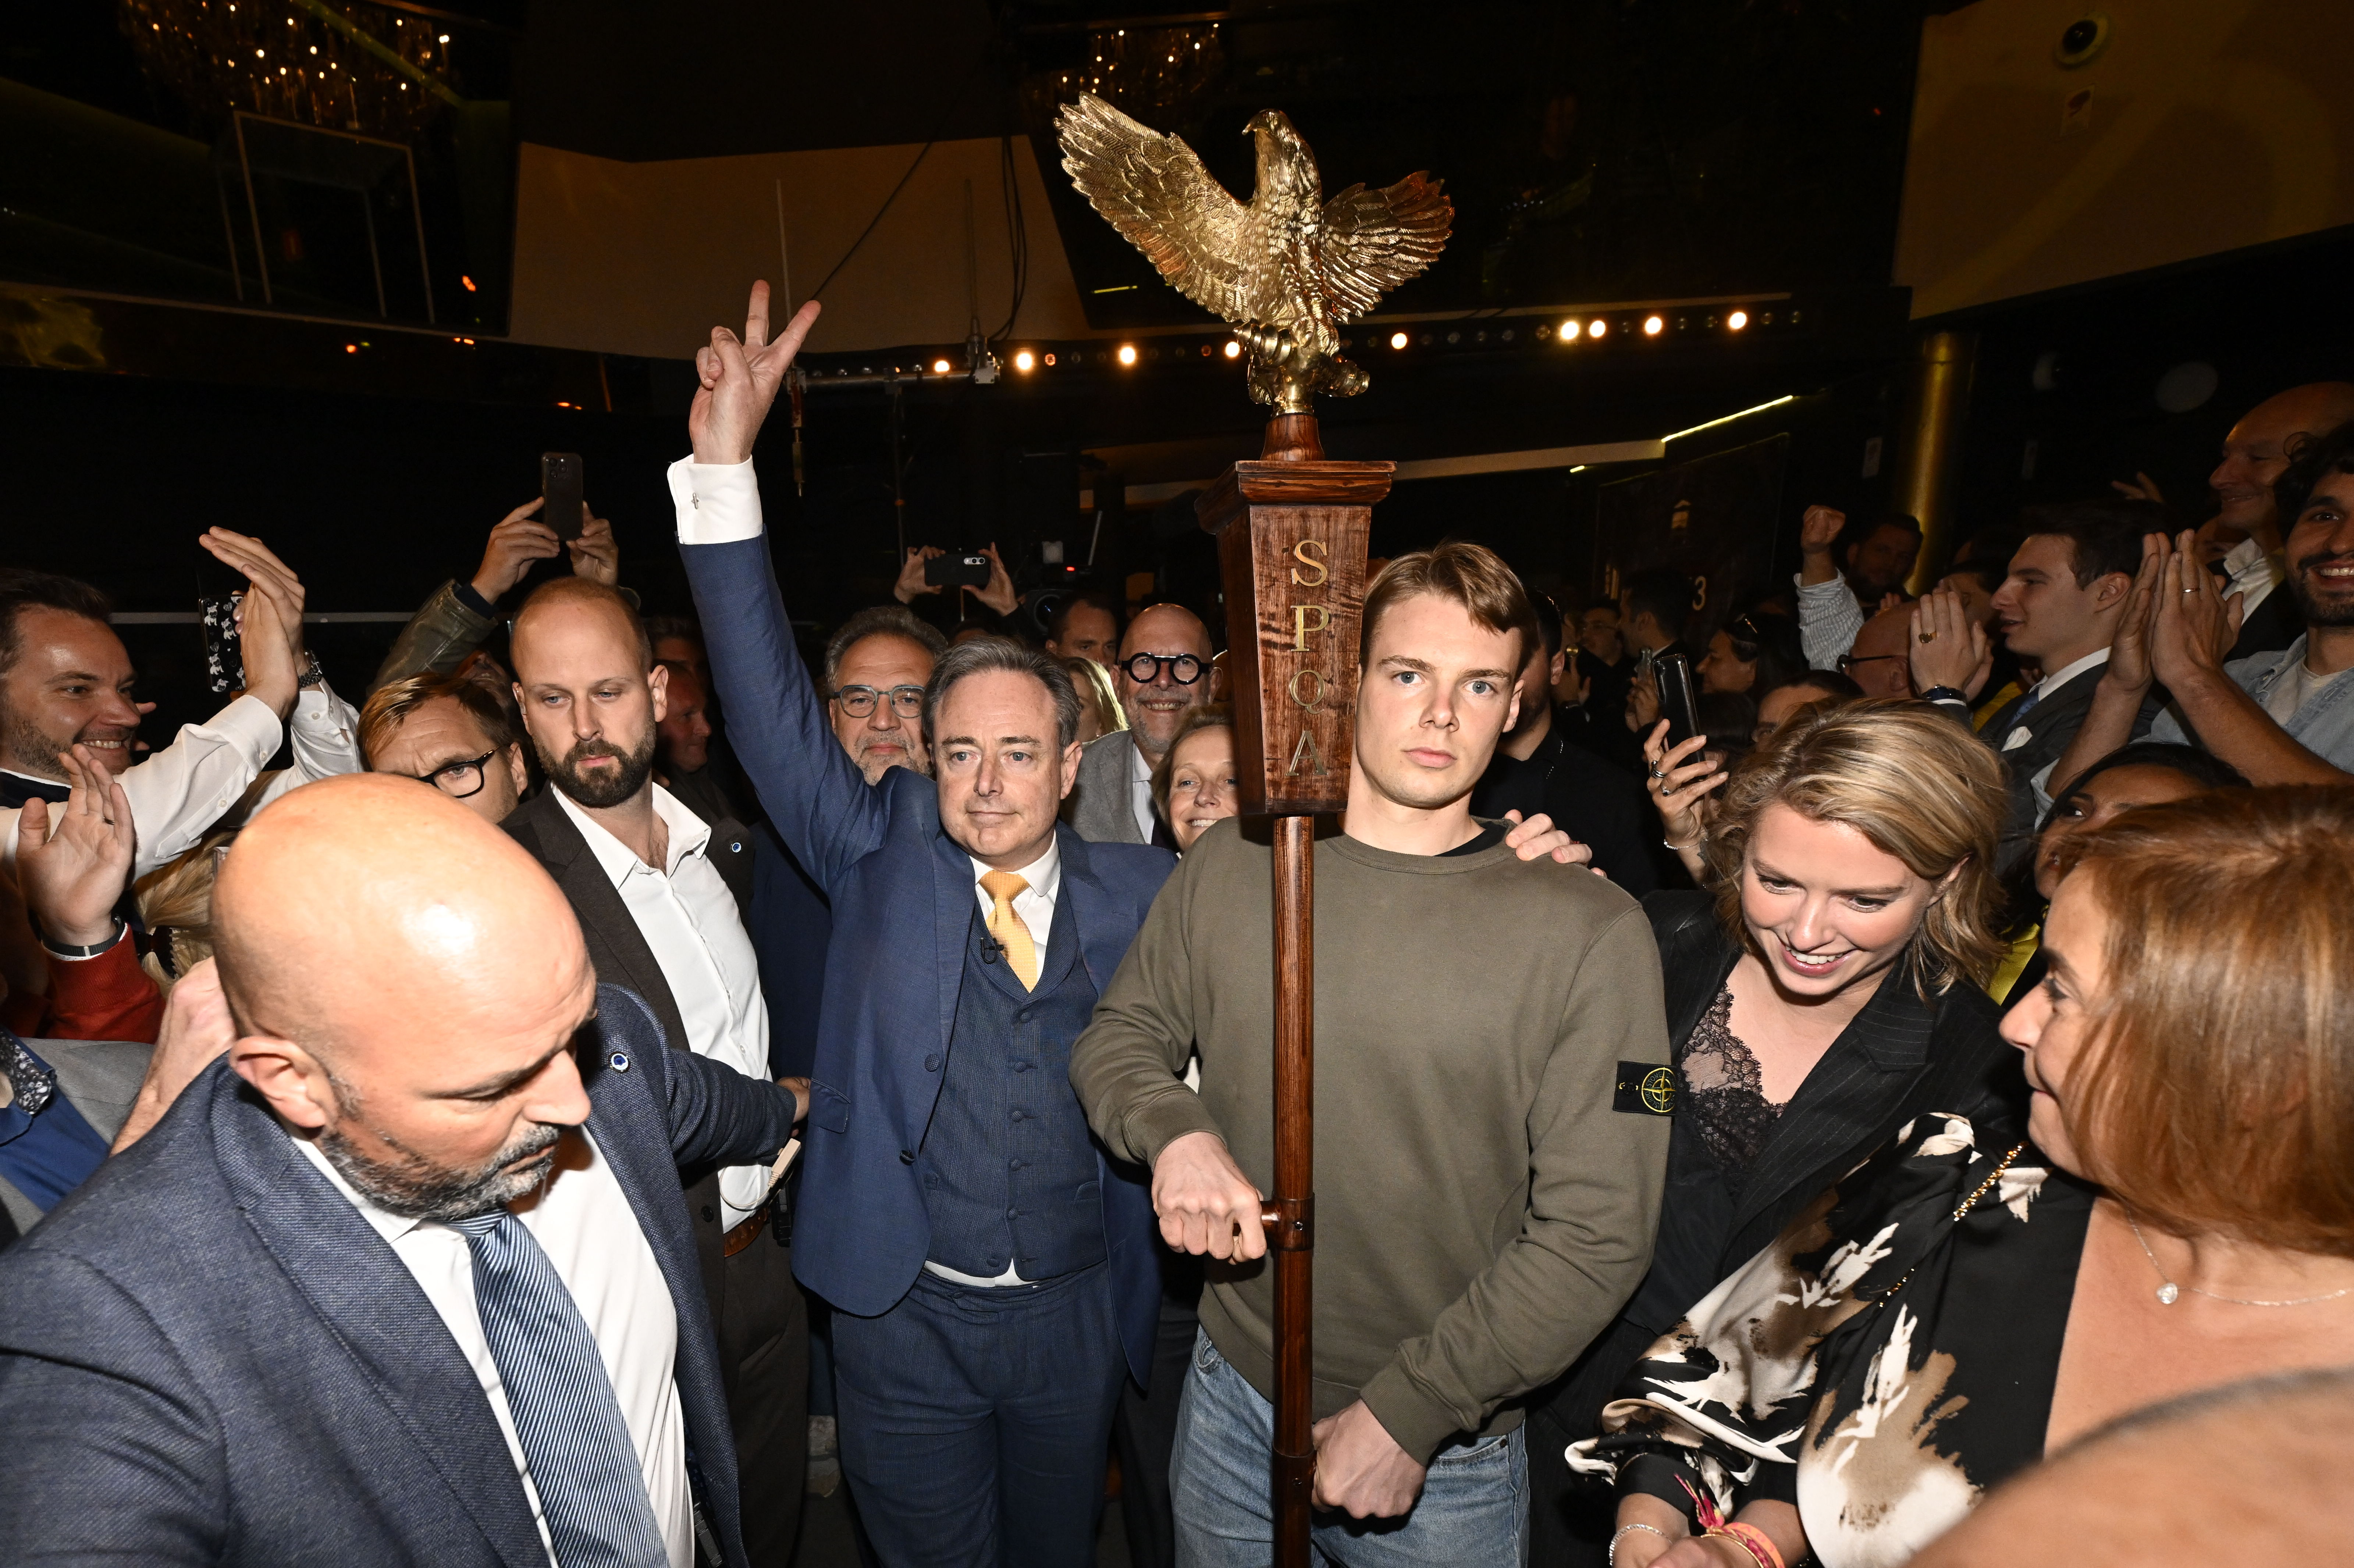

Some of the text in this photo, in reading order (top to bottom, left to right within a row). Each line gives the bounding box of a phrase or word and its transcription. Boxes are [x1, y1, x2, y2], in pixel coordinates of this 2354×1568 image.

[1285, 539, 1329, 776] SPQA
[1646, 1071, 1662, 1087] STONE
[1645, 1091, 1660, 1109] ISLAND
